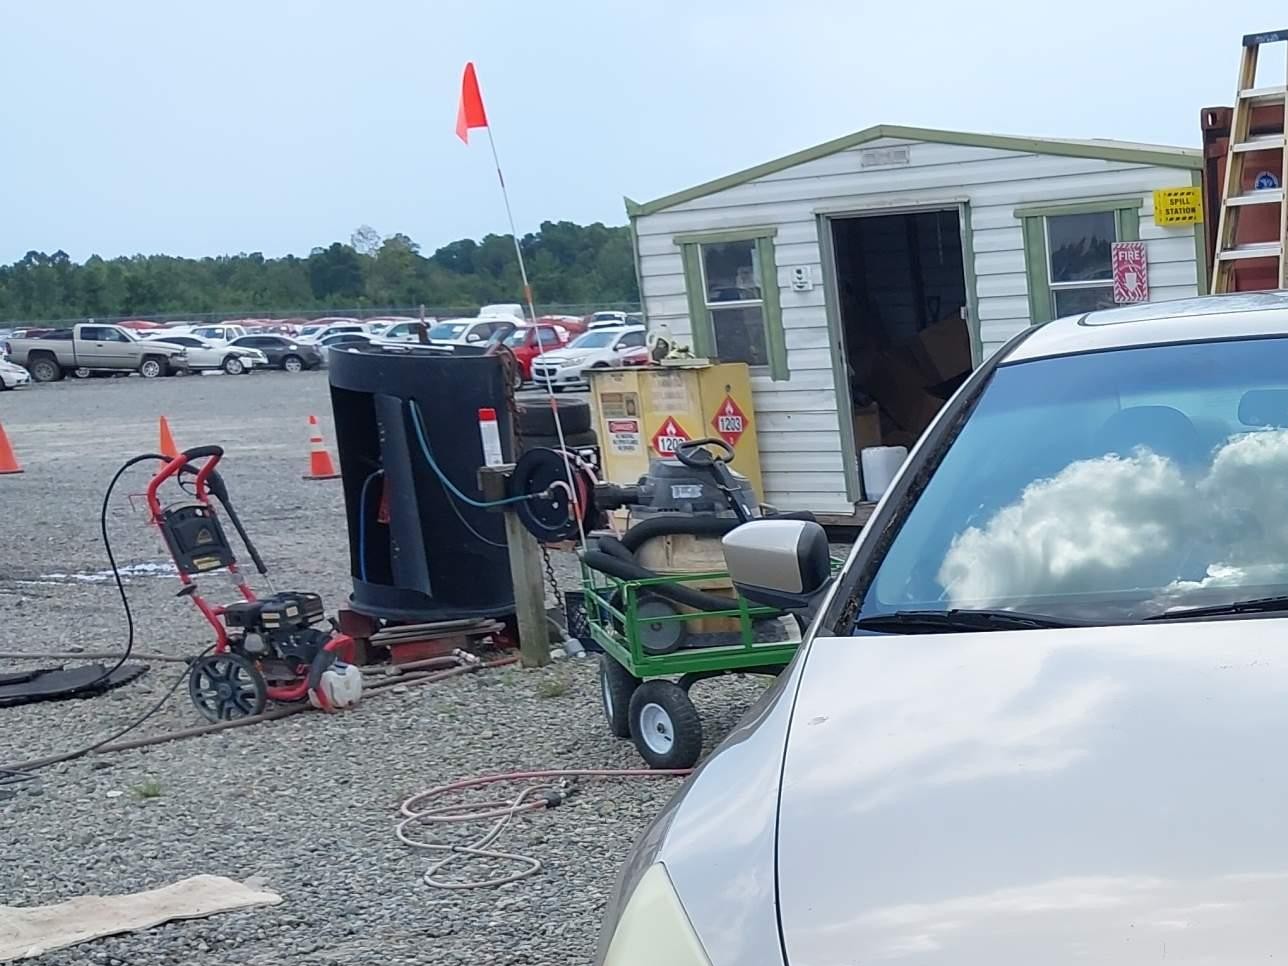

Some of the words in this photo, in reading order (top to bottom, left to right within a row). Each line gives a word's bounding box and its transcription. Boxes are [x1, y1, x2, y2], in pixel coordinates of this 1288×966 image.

[1169, 198, 1190, 206] SPILL
[1165, 207, 1196, 215] STATION
[1119, 250, 1141, 260] FIRE
[720, 417, 741, 430] 1203
